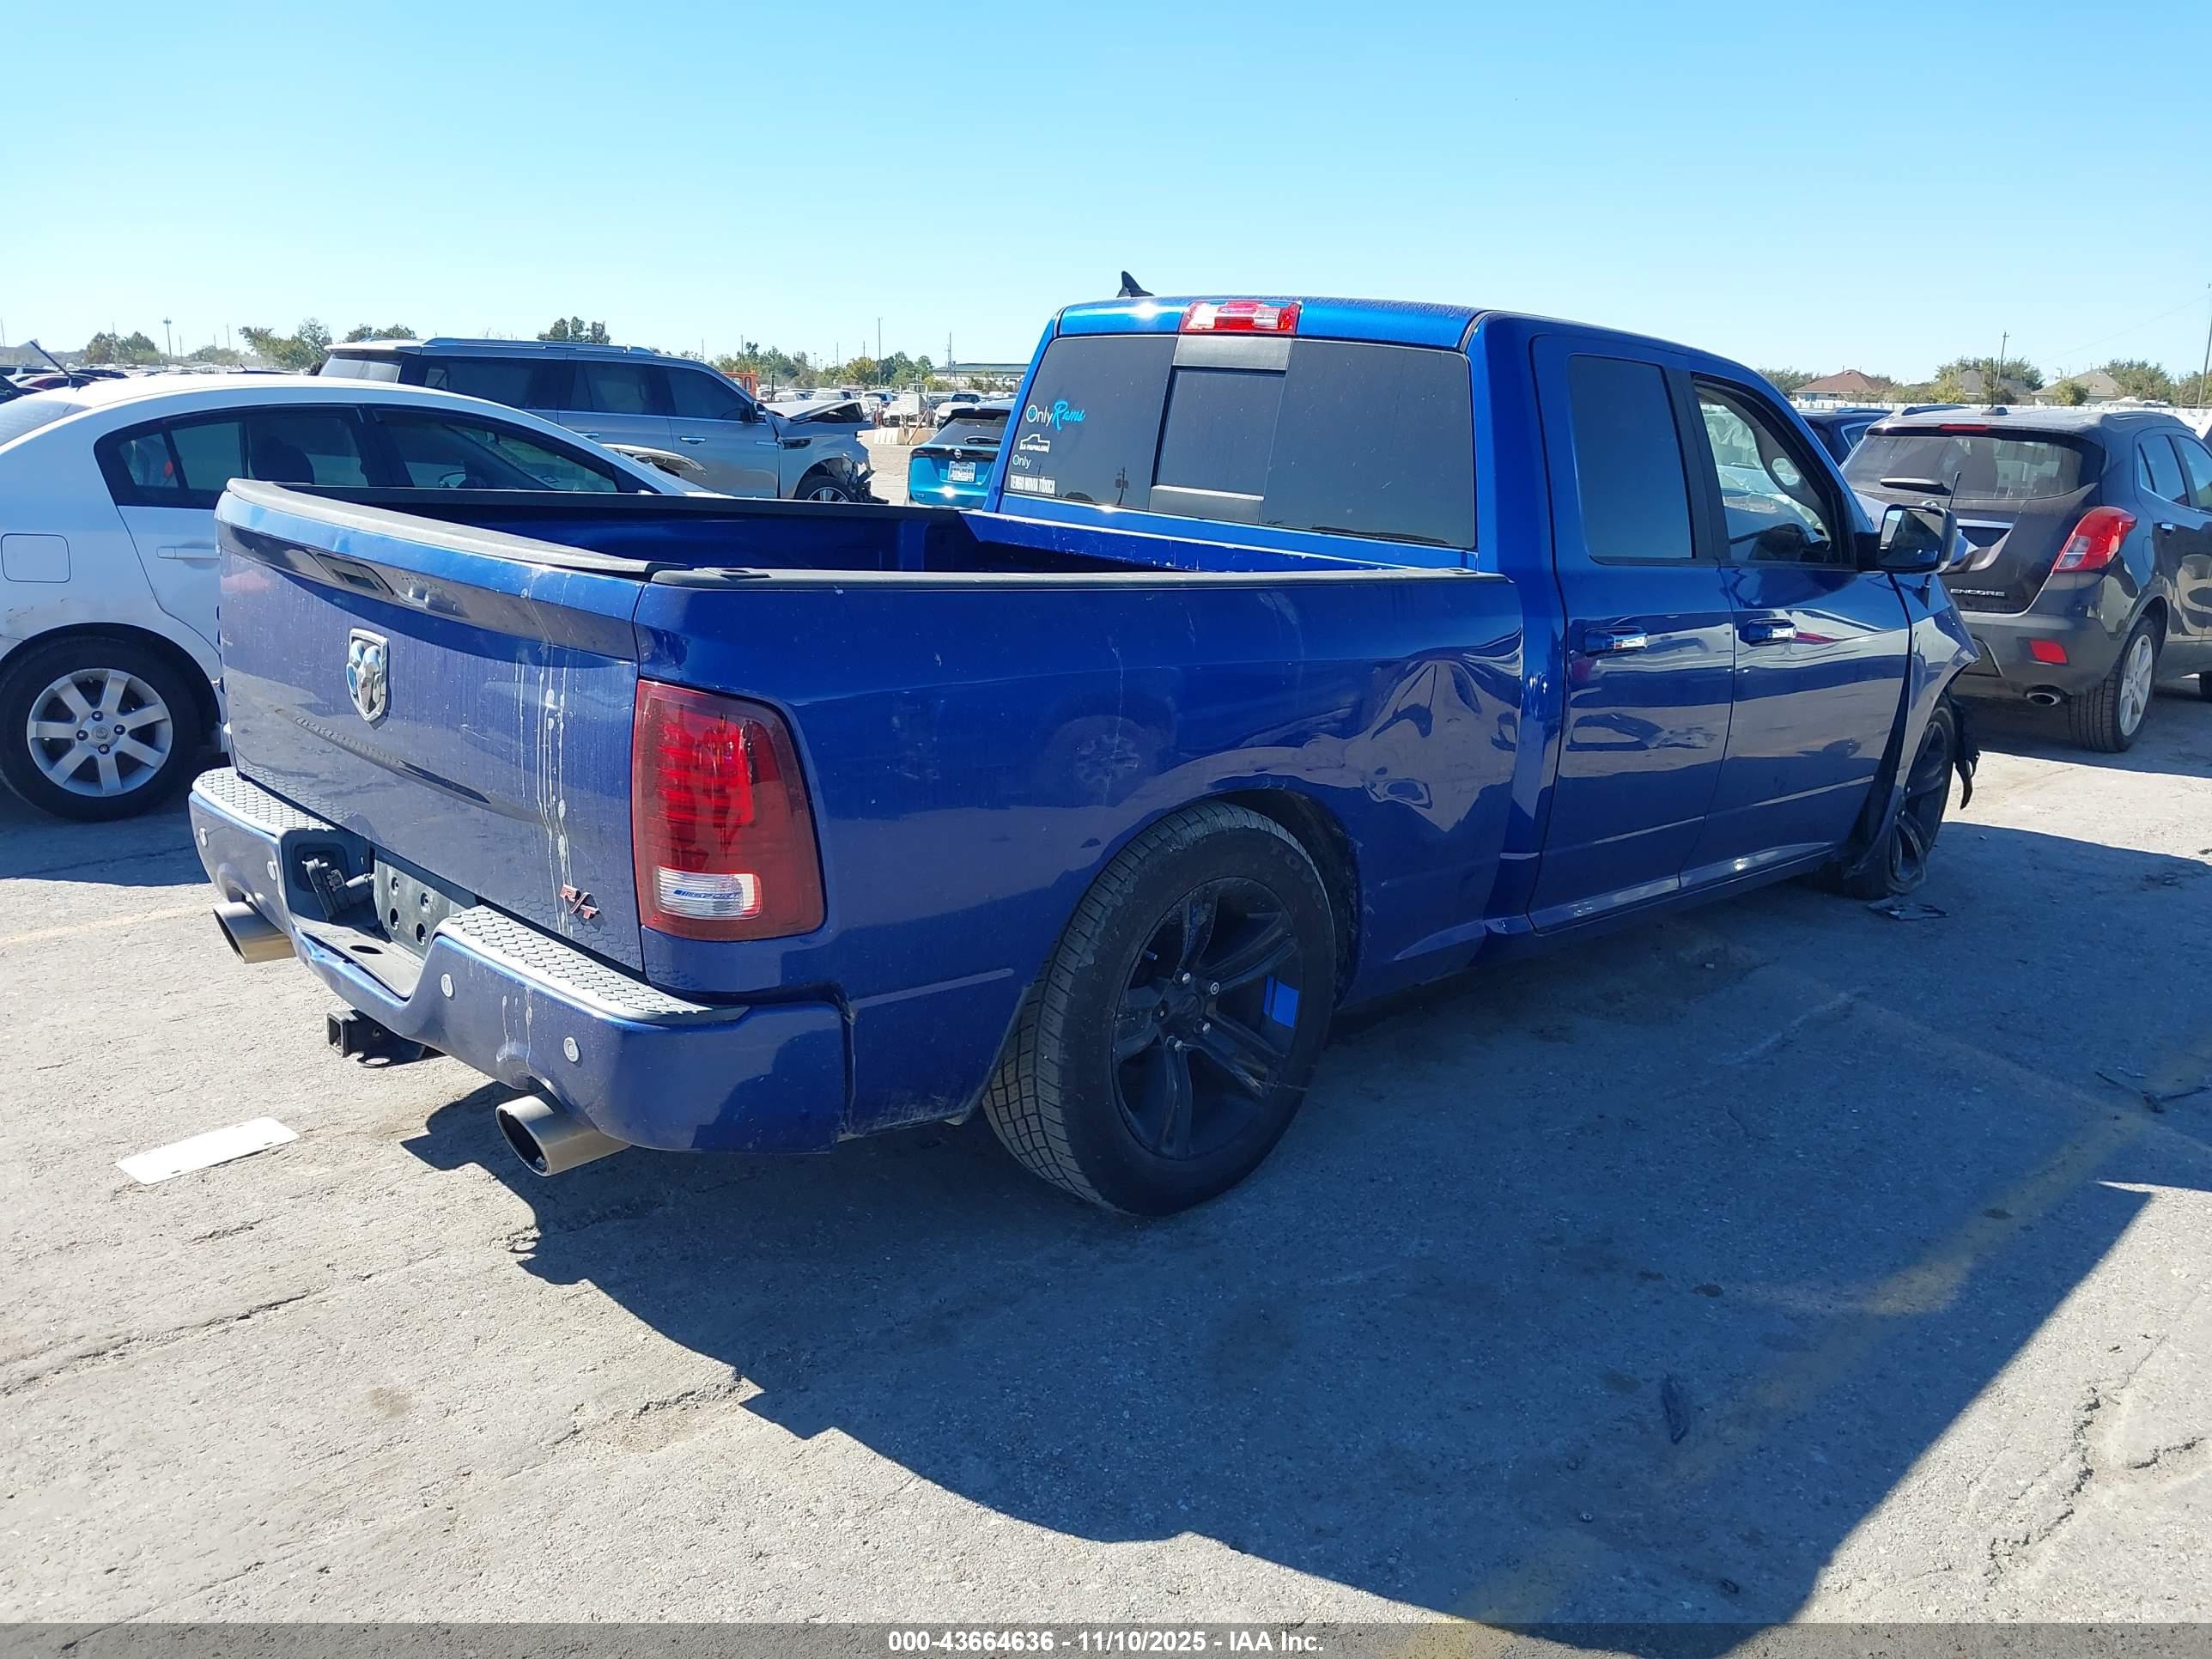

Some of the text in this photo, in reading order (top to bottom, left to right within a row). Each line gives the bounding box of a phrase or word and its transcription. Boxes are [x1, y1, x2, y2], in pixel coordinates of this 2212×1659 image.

[1012, 454, 1031, 469] Only
[1950, 588, 2005, 597] ENCORE
[559, 884, 599, 920] R/T
